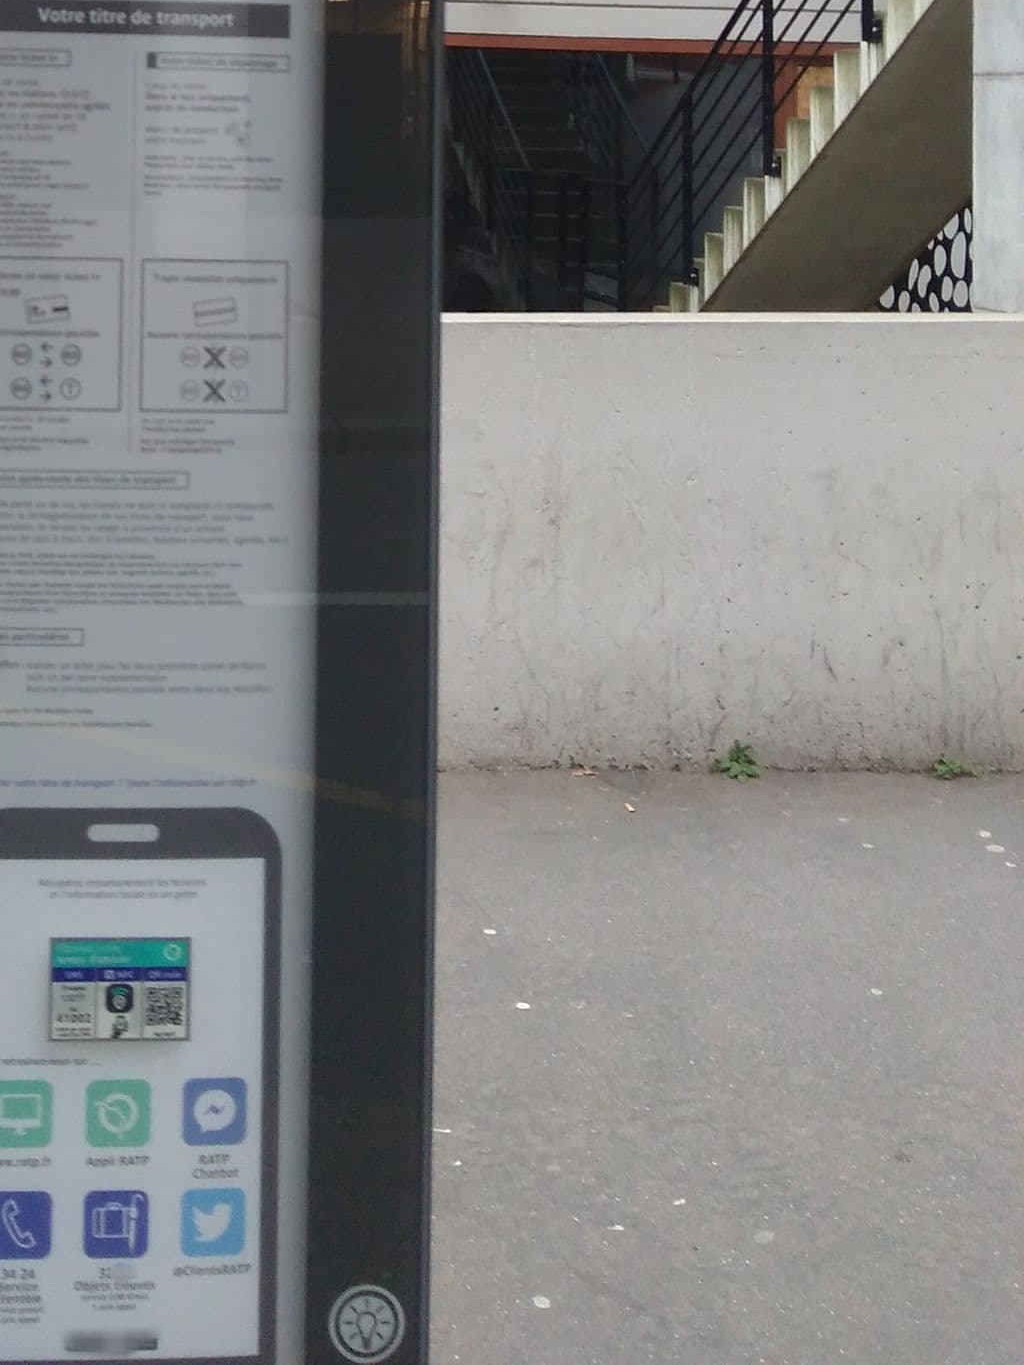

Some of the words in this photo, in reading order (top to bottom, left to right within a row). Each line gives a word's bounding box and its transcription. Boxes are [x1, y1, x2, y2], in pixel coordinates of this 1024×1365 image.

[38, 7, 85, 25] Votre
[89, 8, 126, 25] titre
[130, 9, 152, 26] de
[156, 10, 234, 29] transport
